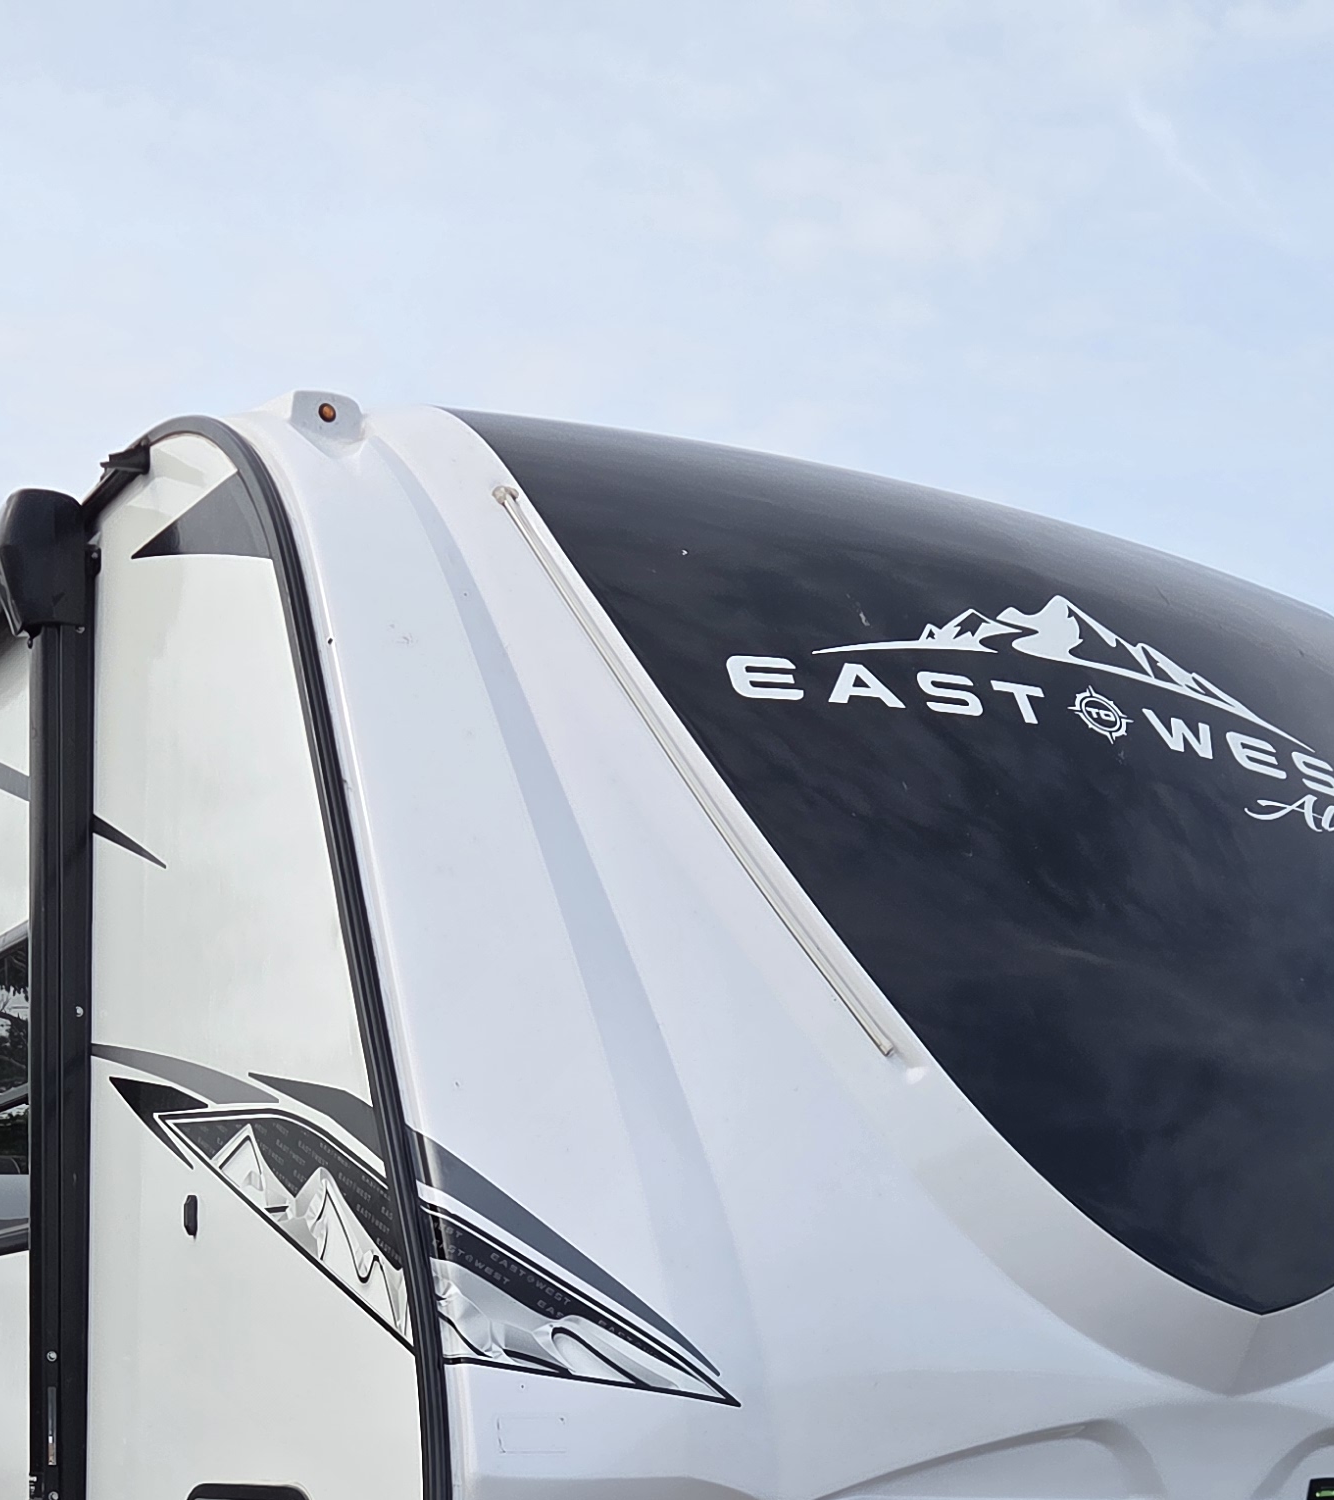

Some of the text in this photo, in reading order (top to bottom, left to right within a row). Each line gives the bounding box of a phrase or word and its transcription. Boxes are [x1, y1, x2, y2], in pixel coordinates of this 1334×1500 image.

[725, 655, 1045, 725] EAST
[1085, 706, 1116, 722] TO
[474, 1259, 510, 1285] WEST
[535, 1280, 571, 1306] WEST
[536, 1299, 564, 1318] EAS
